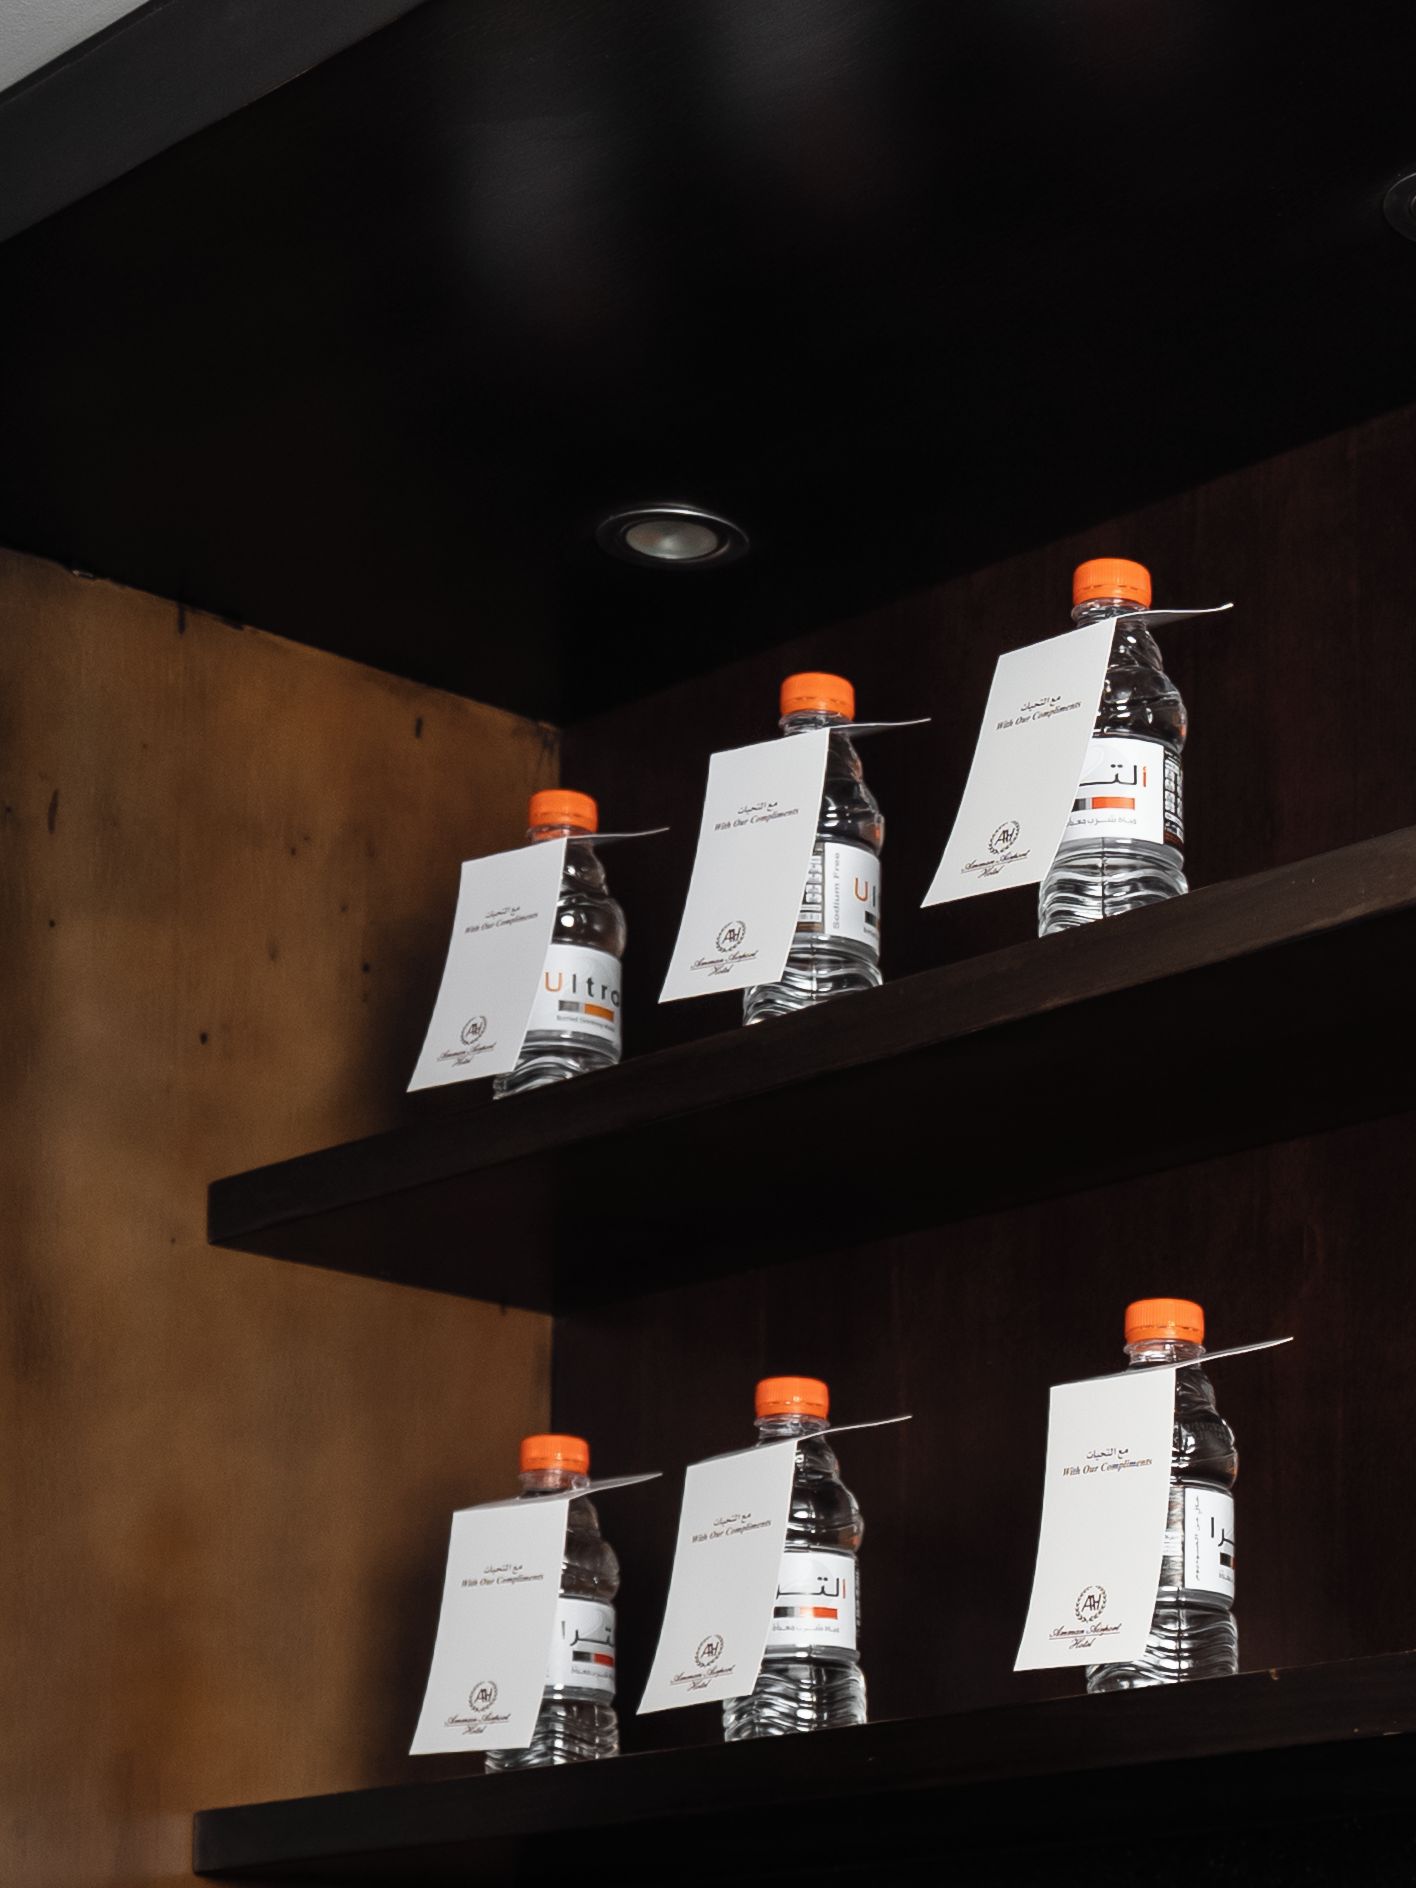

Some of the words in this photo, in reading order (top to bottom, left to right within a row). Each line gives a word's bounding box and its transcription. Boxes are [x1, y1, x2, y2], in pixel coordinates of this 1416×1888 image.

[1117, 1448, 1129, 1460] مع
[1062, 1465, 1081, 1476] With
[1082, 1464, 1099, 1475] Our
[1099, 1457, 1153, 1473] Compliments
[1068, 1637, 1096, 1650] Hotel
